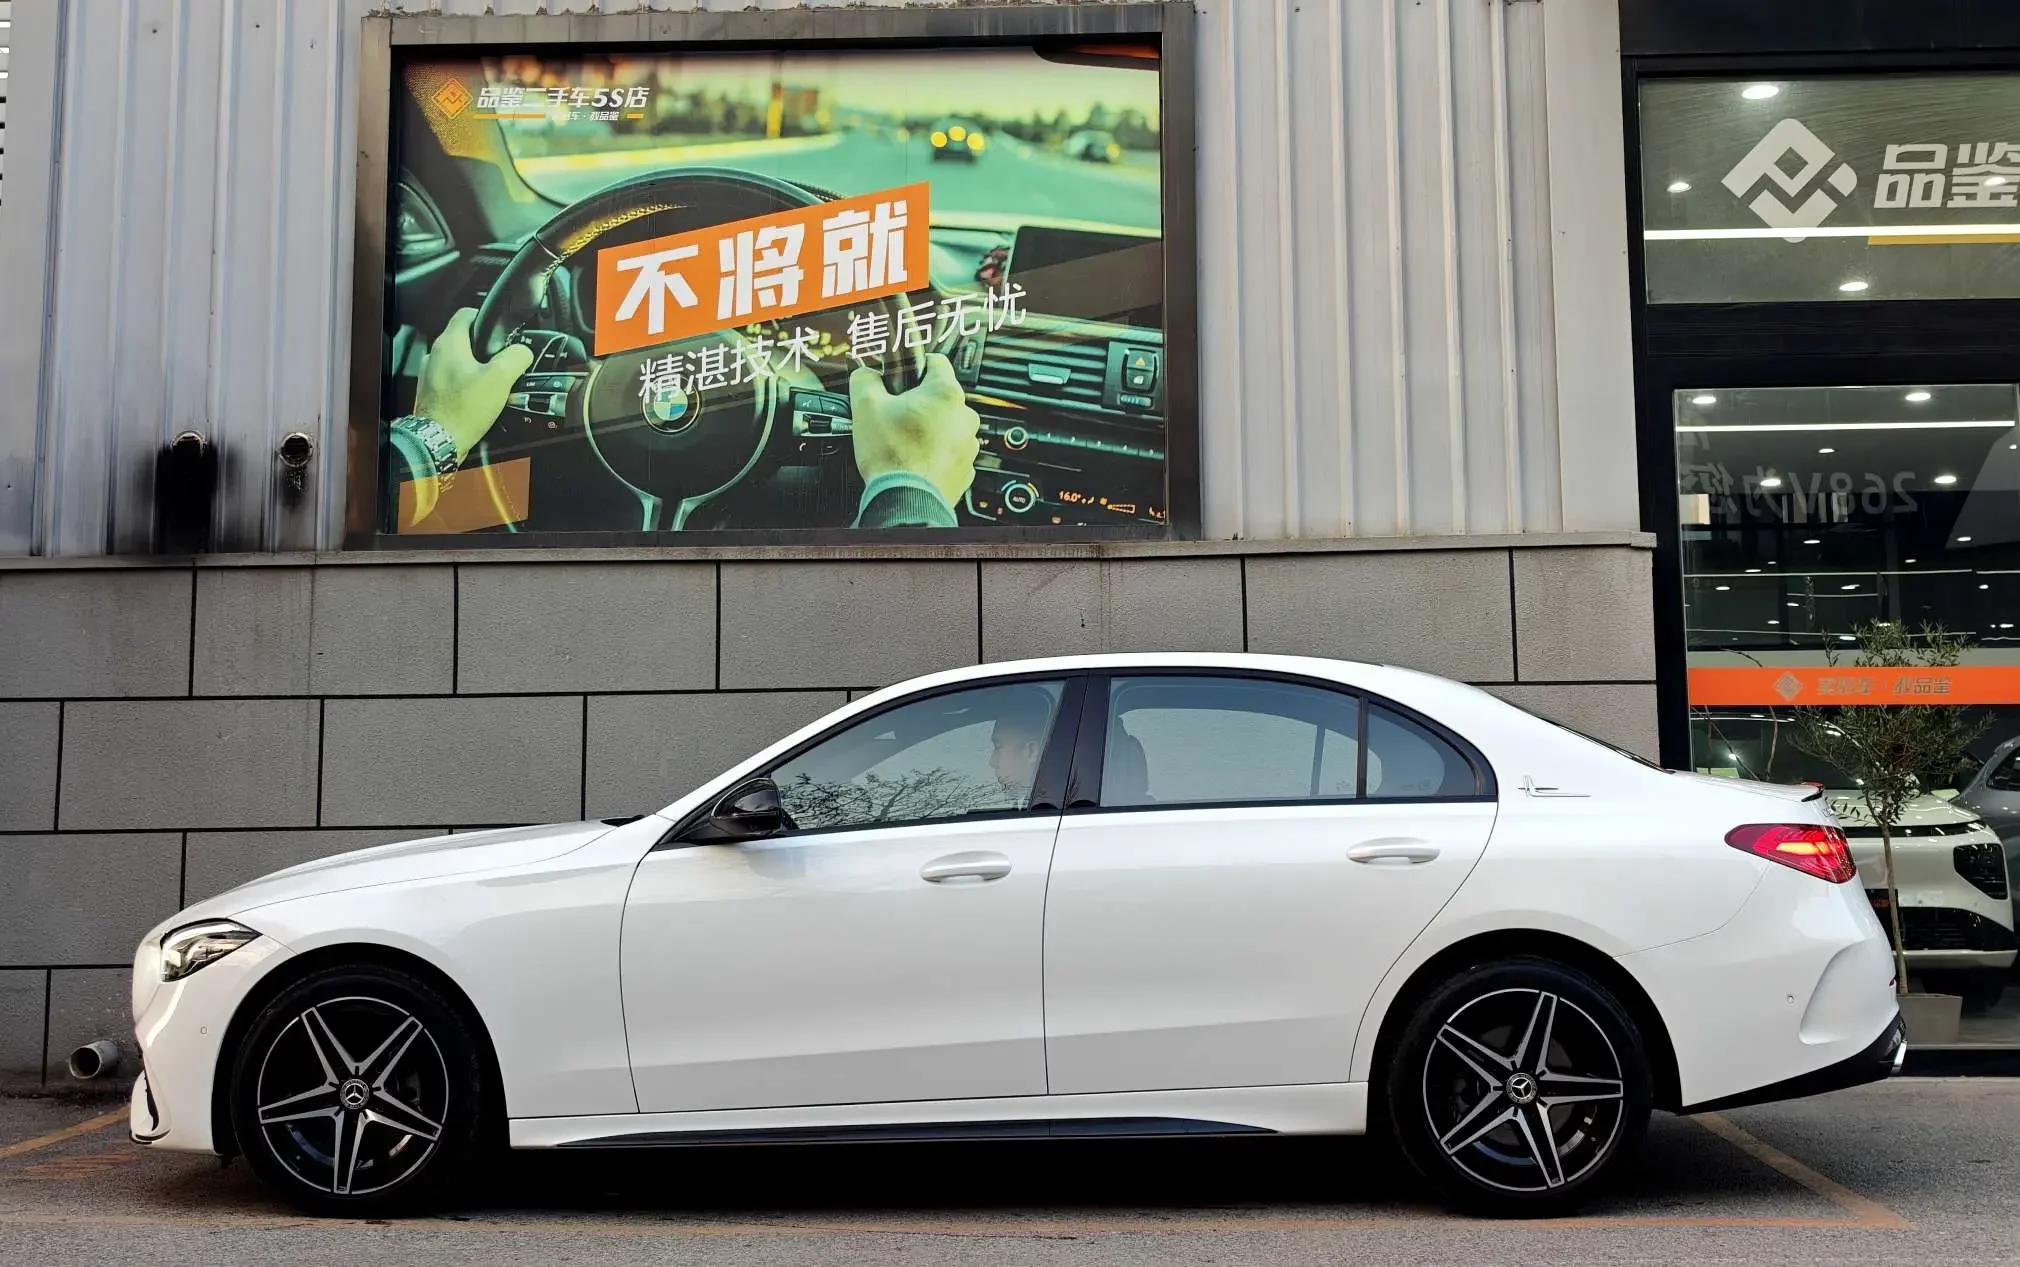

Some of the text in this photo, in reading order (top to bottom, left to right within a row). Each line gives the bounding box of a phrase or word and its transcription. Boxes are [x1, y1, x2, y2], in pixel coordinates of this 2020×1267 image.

[477, 87, 650, 108] 品鉴二手车5S店
[1873, 142, 2020, 209] 品鉴
[615, 200, 908, 336] 不将就
[638, 281, 1027, 403] 精湛技术 售后无忧
